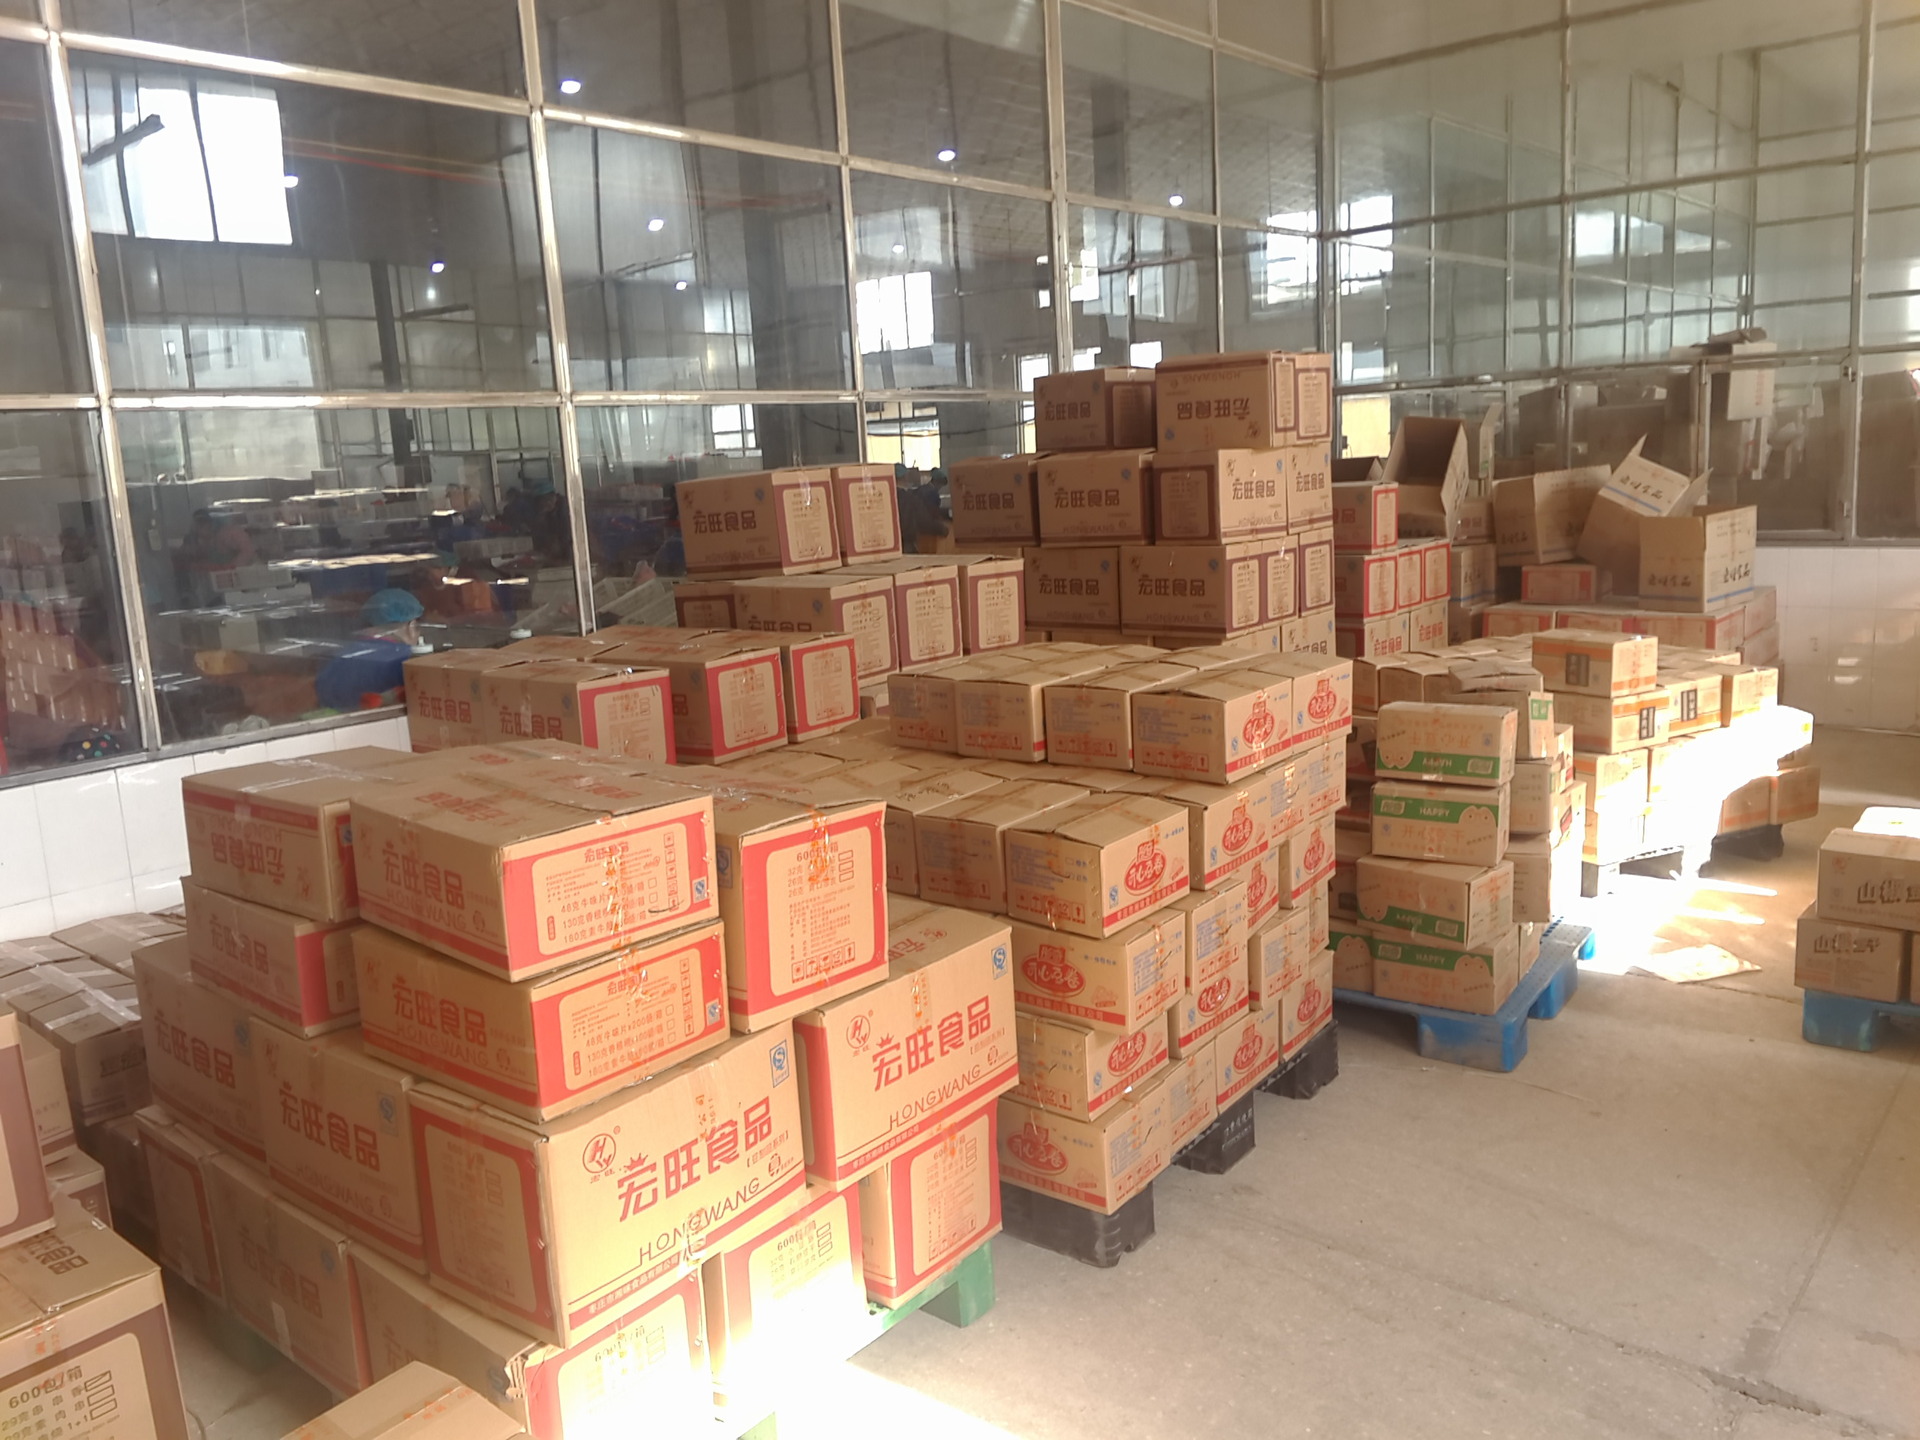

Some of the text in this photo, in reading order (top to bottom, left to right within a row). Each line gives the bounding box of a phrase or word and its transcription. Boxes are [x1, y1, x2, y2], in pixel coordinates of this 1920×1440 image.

[1044, 401, 1091, 421] 宏旺食品
[1177, 398, 1250, 420] 宏旺食品
[1232, 478, 1276, 500] 宏旺食品
[1295, 471, 1325, 492] 宏旺食品
[963, 490, 1015, 511] 宏旺食品
[1054, 488, 1120, 509] 宏旺食品
[693, 510, 757, 534] 宏旺食品
[1039, 574, 1100, 595] 宏旺食品
[1138, 574, 1206, 596] 宏旺食品
[1418, 621, 1443, 642] 宏旺食品
[1373, 636, 1402, 658] 宏旺食品
[418, 692, 472, 724] 宏旺食品
[500, 706, 563, 741] 宏旺食品
[1420, 807, 1450, 817] HAPPY
[211, 832, 285, 886] 宏旺食品
[382, 840, 465, 910] 宏旺食品
[209, 914, 269, 975] 宏旺食品
[1416, 954, 1446, 964] HAPPY
[391, 974, 487, 1048] 宏旺食品
[154, 1009, 236, 1089] 宏旺食品
[871, 995, 992, 1092] 宏旺食品
[889, 1064, 981, 1133] HONGWANG
[279, 1080, 380, 1172] 宏旺食品
[617, 1095, 772, 1223] 宏旺食品
[640, 1177, 760, 1266] HONGWANG
[238, 1225, 323, 1319] 宏旺食品
